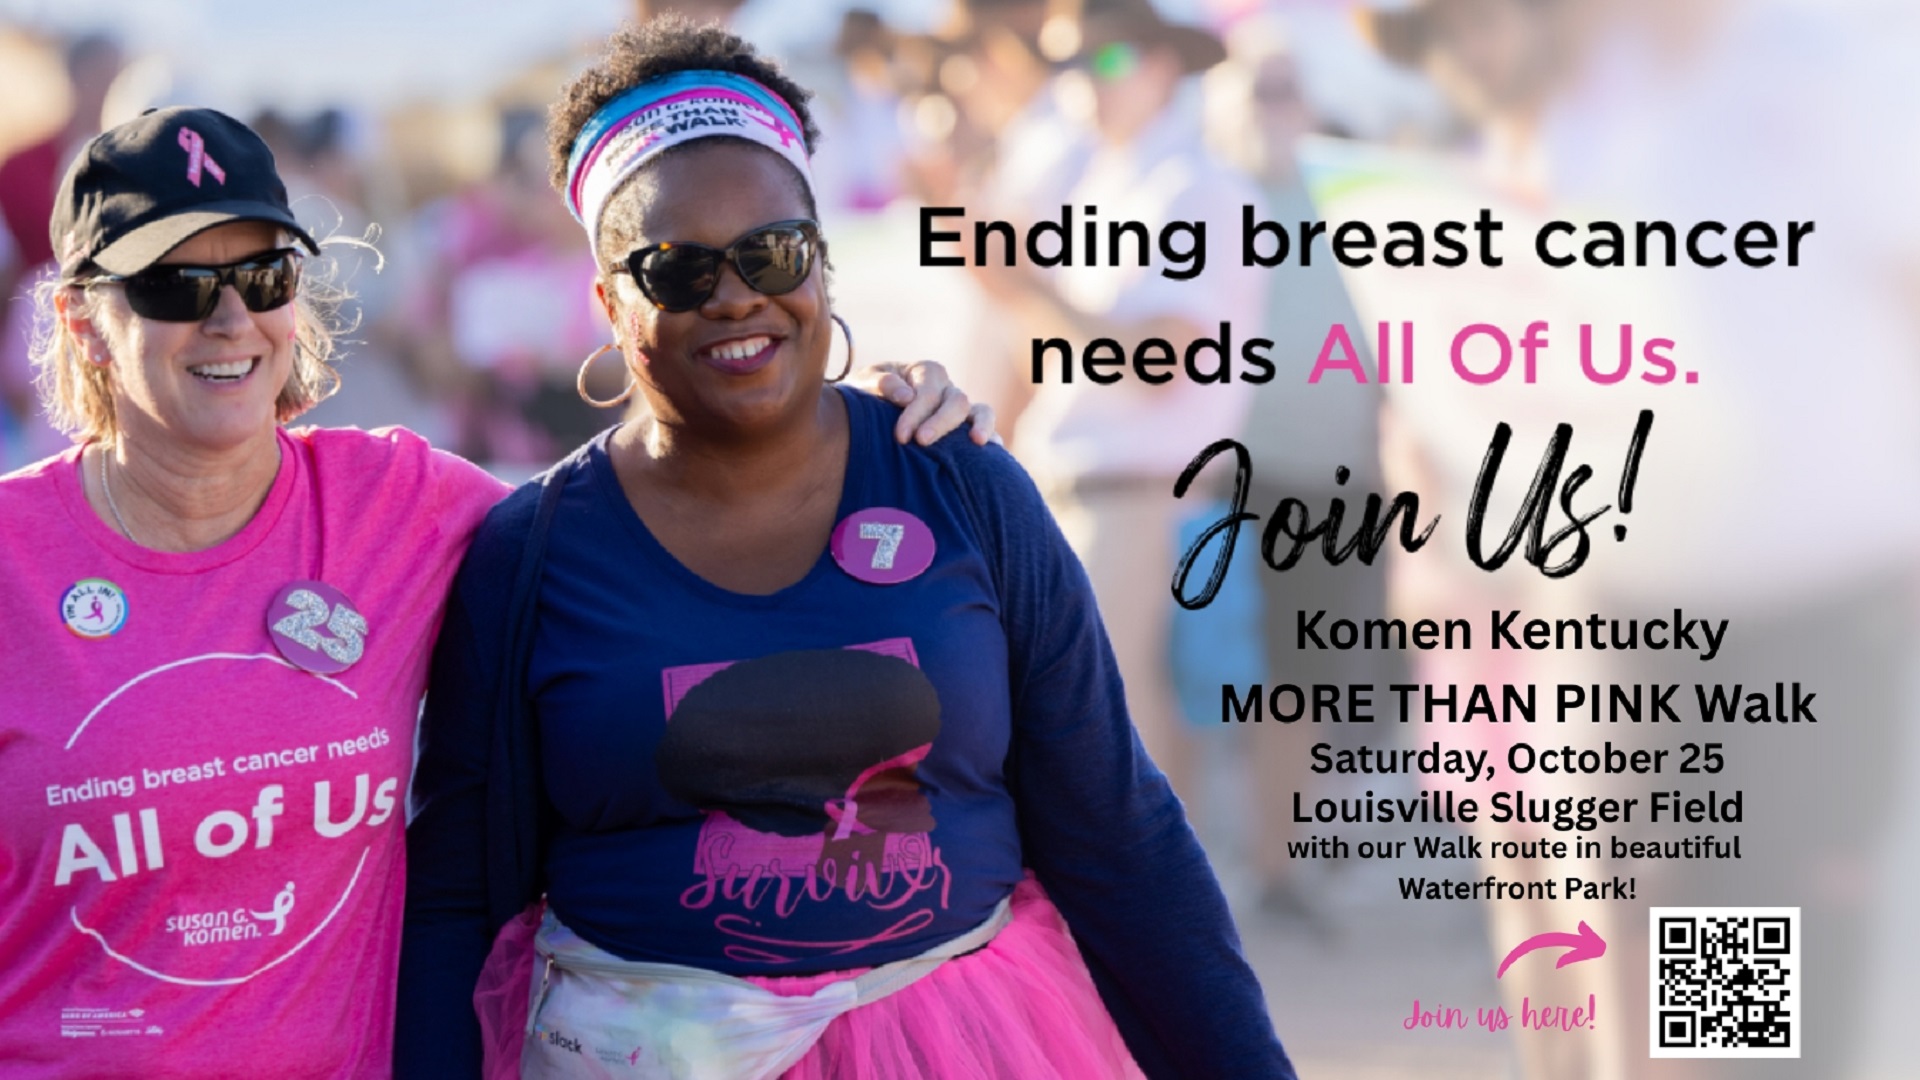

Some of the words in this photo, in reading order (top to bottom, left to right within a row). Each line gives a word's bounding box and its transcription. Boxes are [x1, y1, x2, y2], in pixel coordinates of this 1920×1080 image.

[664, 115, 745, 136] WALK
[666, 106, 739, 121] THAN
[859, 523, 904, 570] 7
[70, 586, 95, 603] ALL
[272, 589, 368, 665] 25
[46, 774, 136, 807] Ending
[143, 756, 226, 790] breast
[232, 743, 319, 774] cancer
[327, 726, 390, 759] needs
[53, 807, 165, 887] All
[193, 783, 285, 859] of
[313, 773, 398, 838] Us
[548, 1030, 583, 1055] slack
